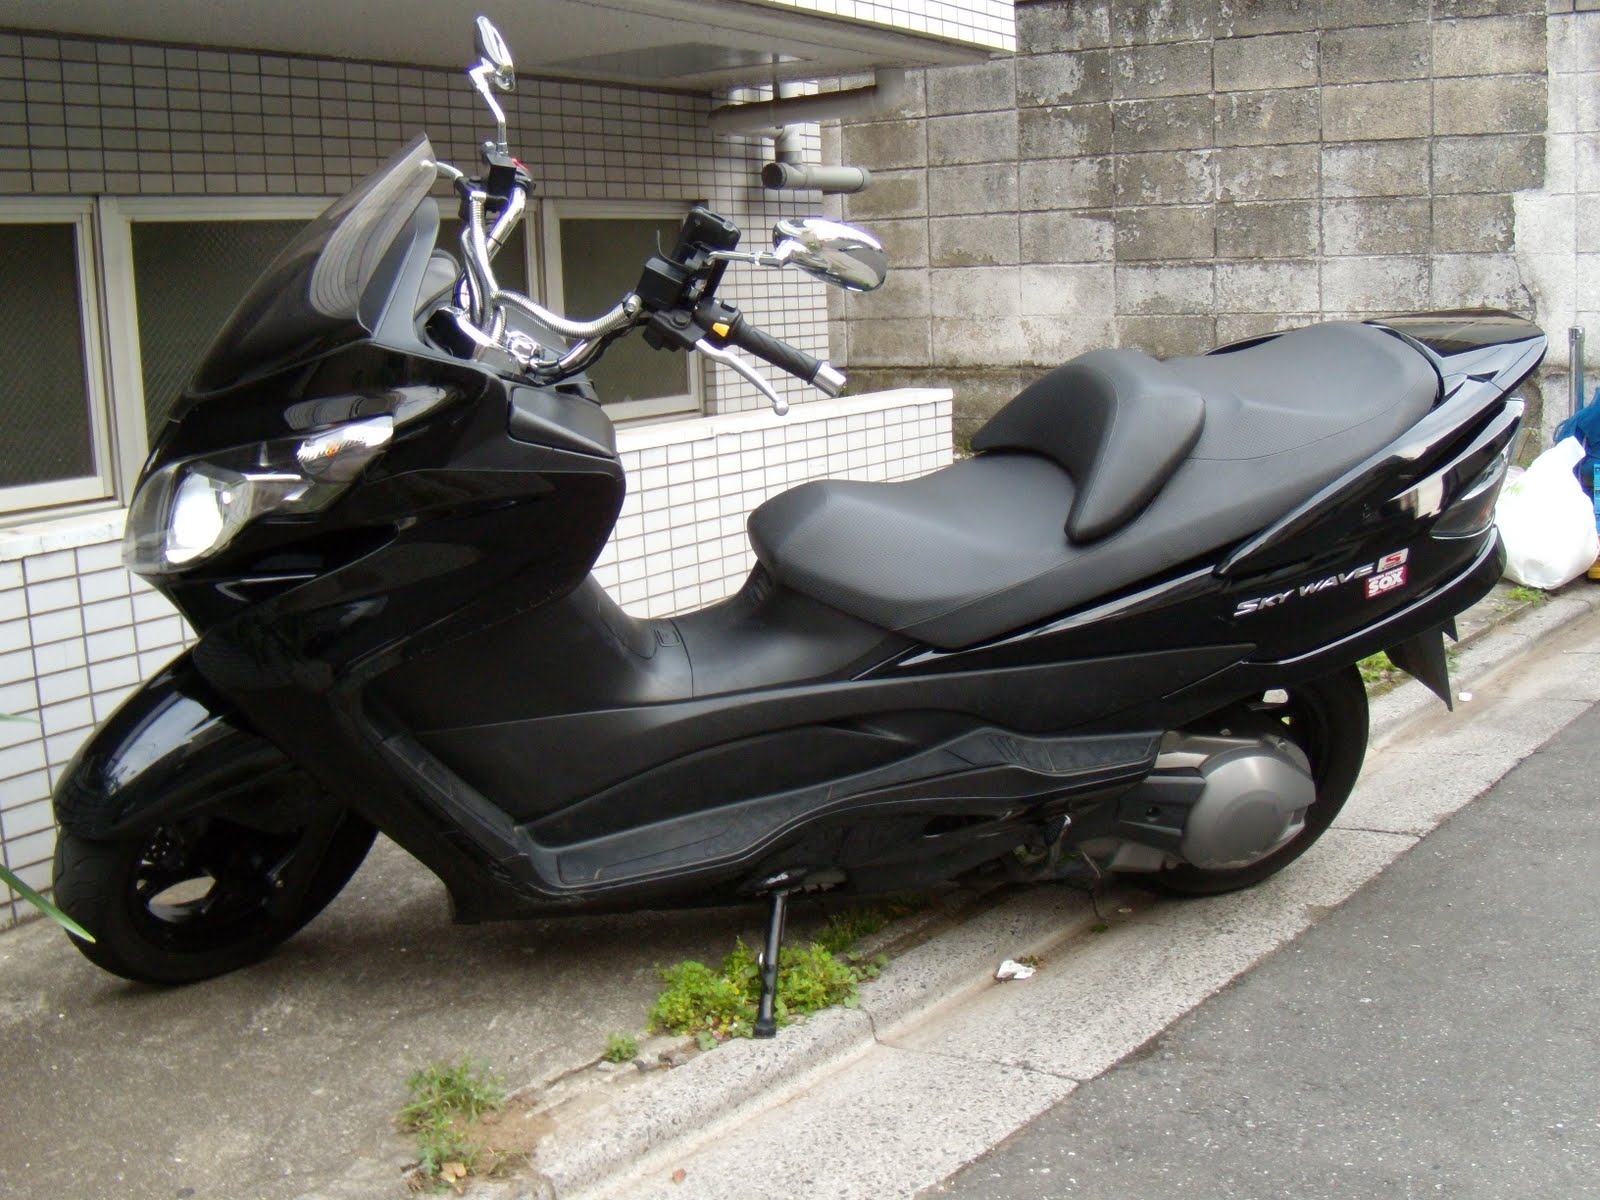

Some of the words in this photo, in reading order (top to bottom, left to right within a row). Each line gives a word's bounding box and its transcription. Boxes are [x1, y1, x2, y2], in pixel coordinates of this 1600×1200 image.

[1233, 589, 1295, 617] SKY
[1299, 562, 1375, 597] WAVE
[1368, 570, 1404, 594] SOX
